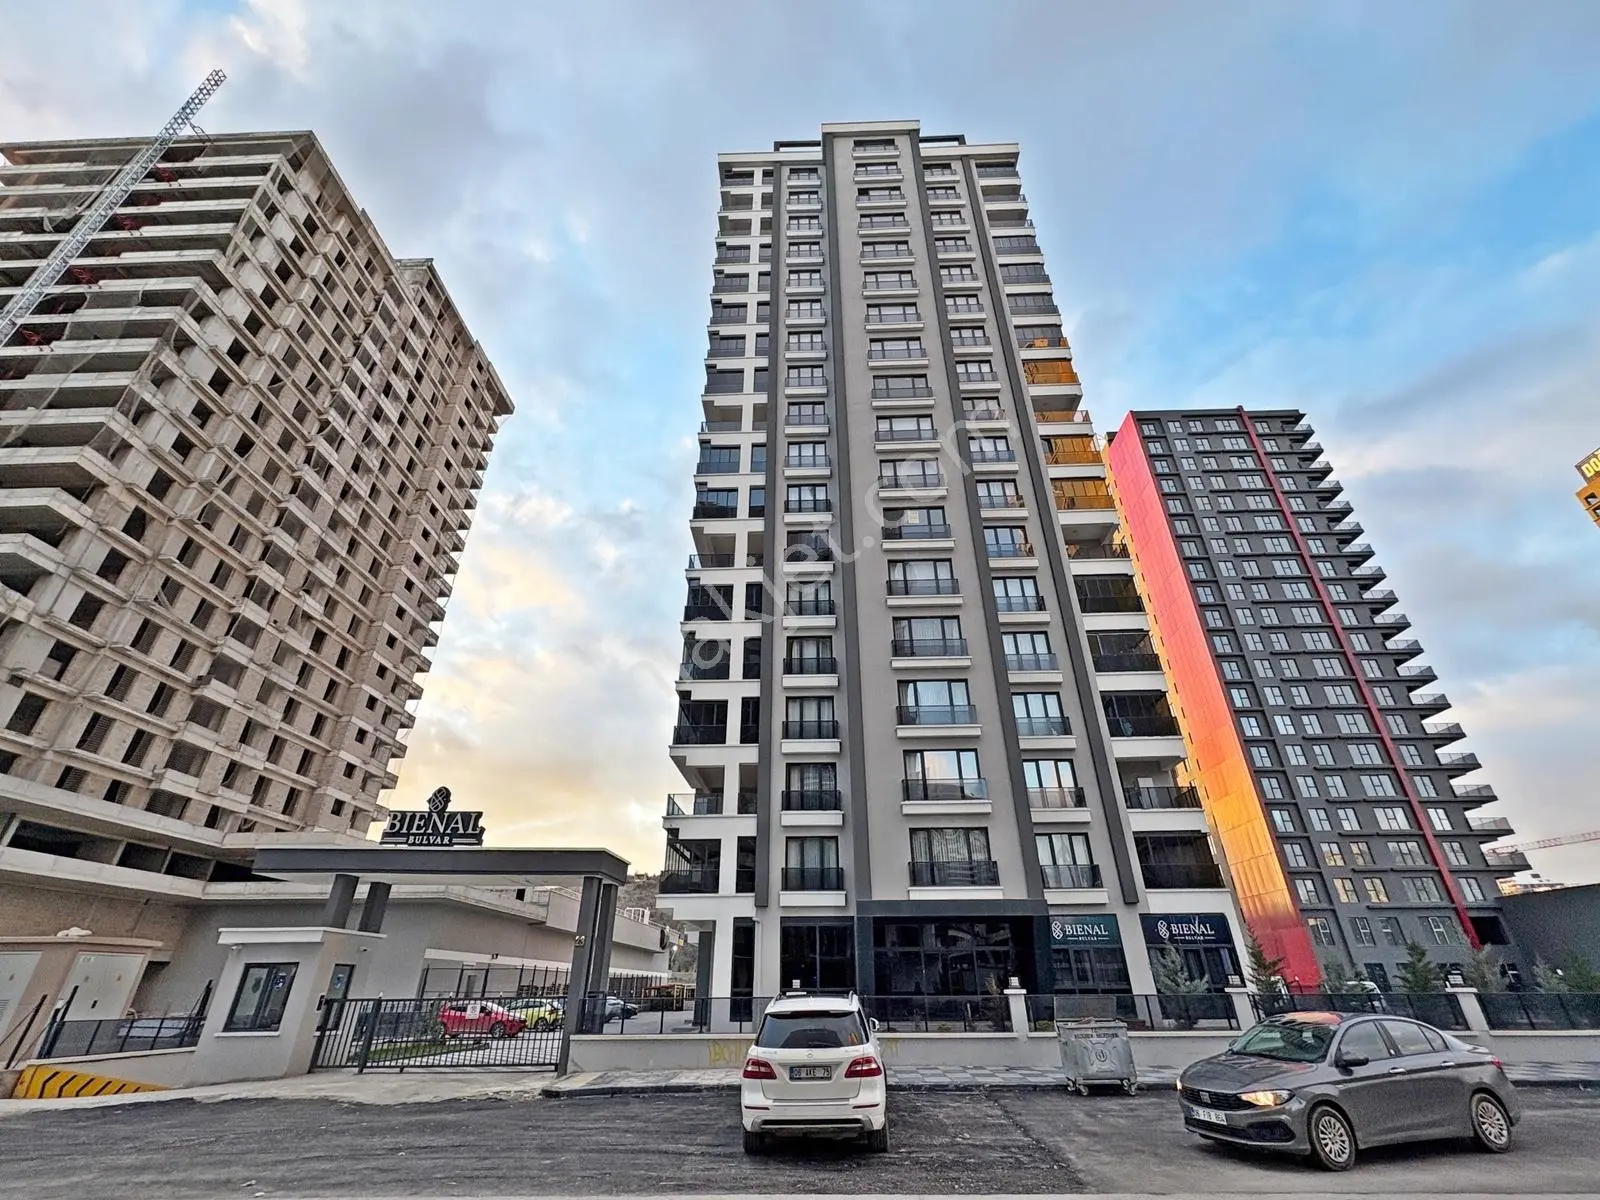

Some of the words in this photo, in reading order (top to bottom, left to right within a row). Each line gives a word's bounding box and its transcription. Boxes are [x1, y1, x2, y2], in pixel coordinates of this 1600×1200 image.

[384, 812, 482, 834] BIENAL
[408, 836, 450, 844] BULVAR
[1065, 924, 1108, 935] BIENAL
[1170, 923, 1215, 934] BIENAL
